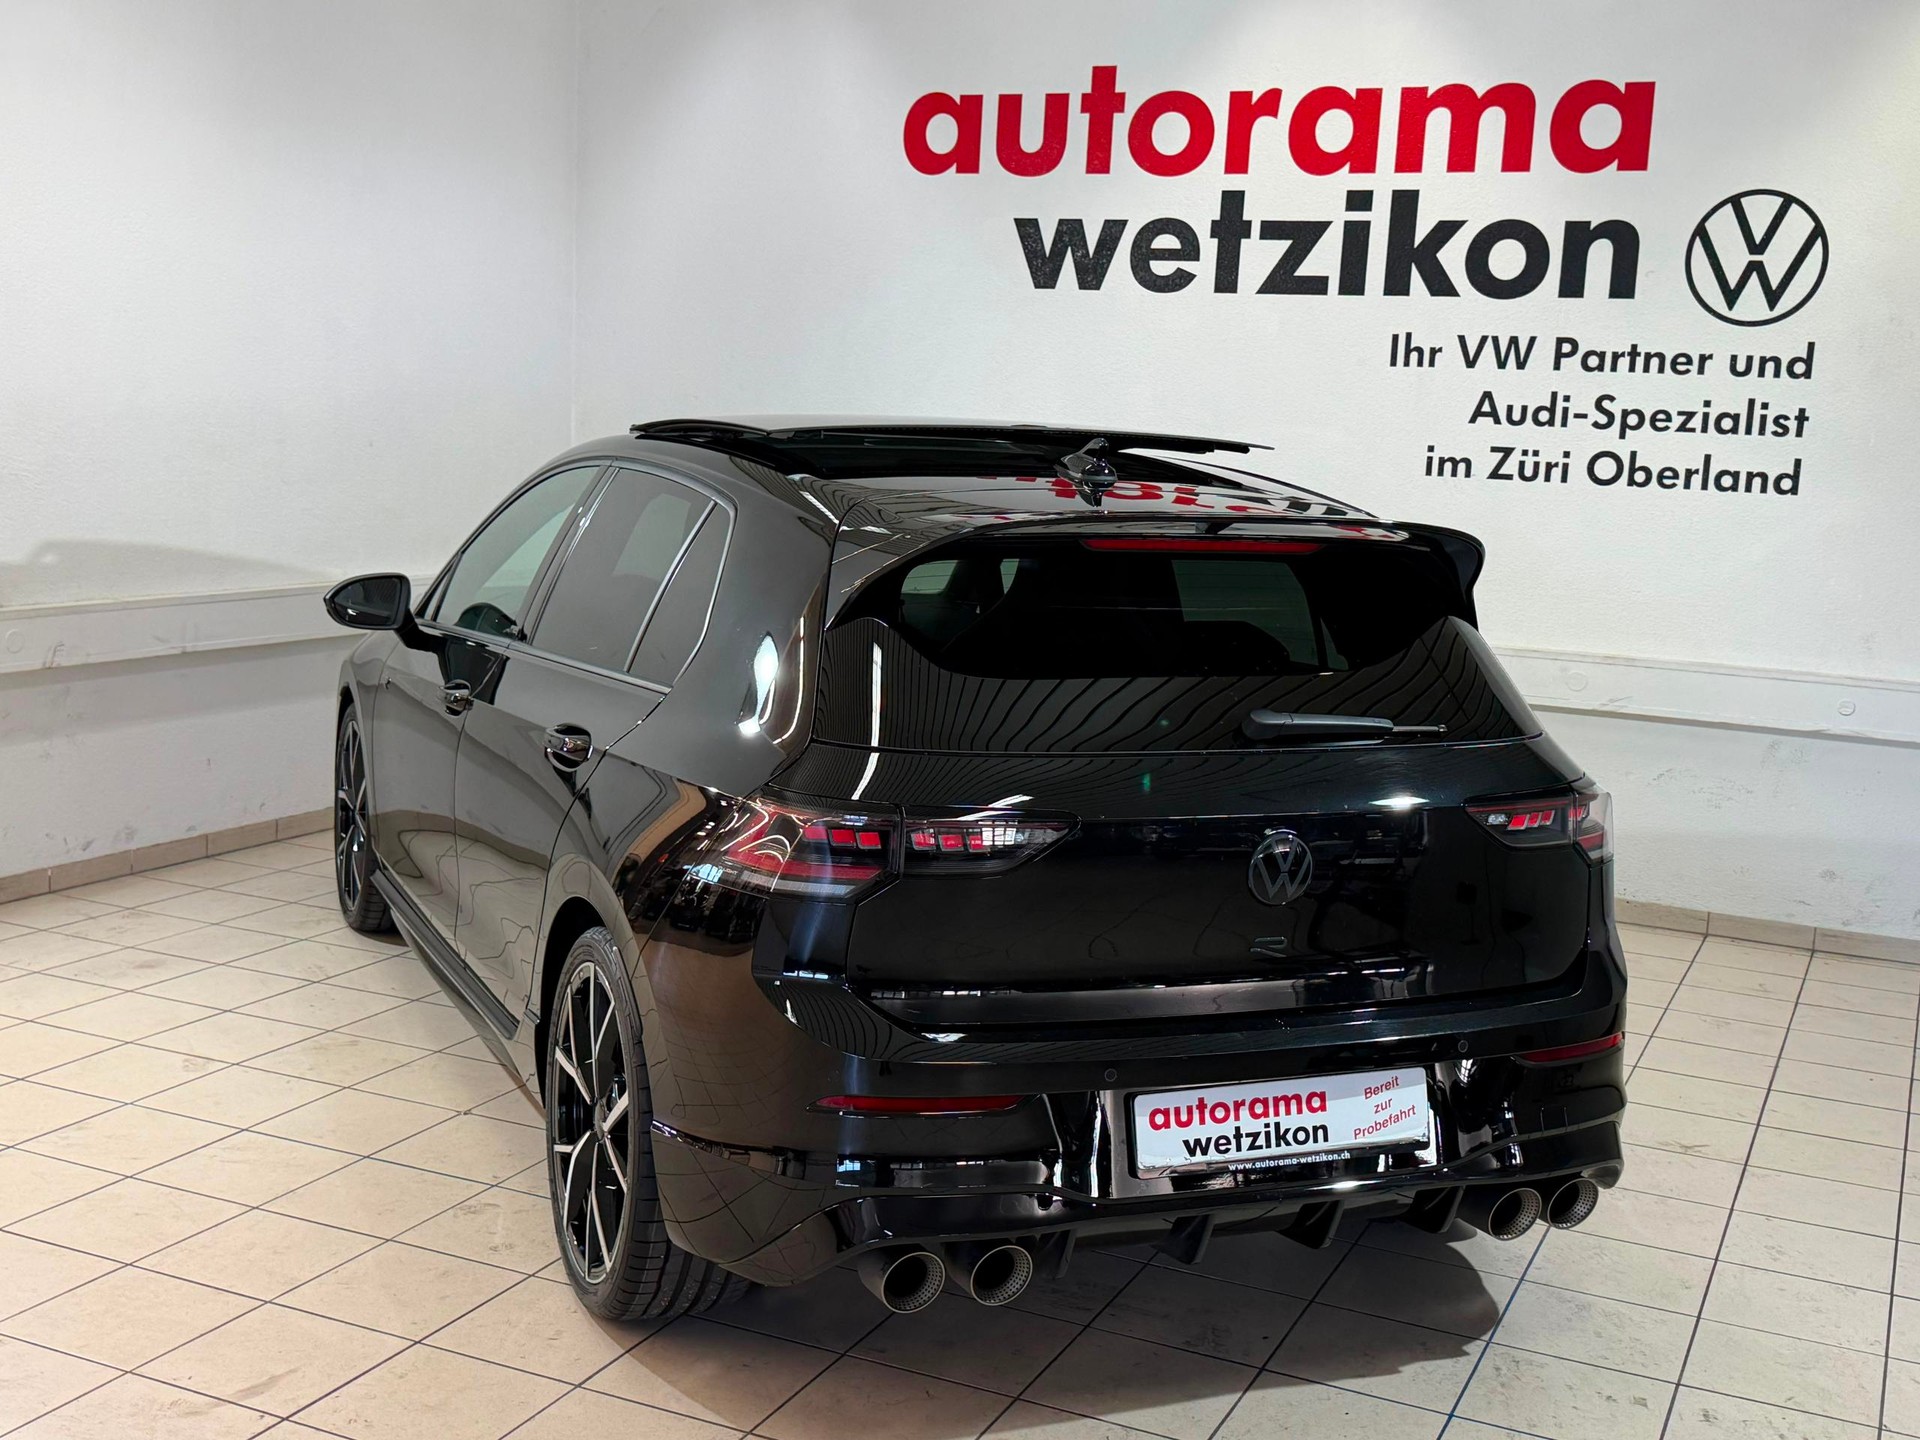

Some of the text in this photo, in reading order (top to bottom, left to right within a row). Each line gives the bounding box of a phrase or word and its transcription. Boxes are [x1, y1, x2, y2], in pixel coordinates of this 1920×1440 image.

[903, 65, 1657, 178] autorama
[1013, 189, 1641, 300] wetzikon
[1389, 331, 1816, 380] Ihr VW Partner und
[1468, 390, 1810, 440] Audi-Spezialist
[1425, 445, 1802, 496] im Züri Oberland
[1364, 1075, 1400, 1100] Bereit
[1373, 1097, 1393, 1115] zur
[1148, 1090, 1327, 1131] autorama
[1353, 1104, 1417, 1140] Probefahrt
[1181, 1121, 1329, 1157] wetzikon
[1227, 1150, 1351, 1172] www.autorama-wetzikon.ch
